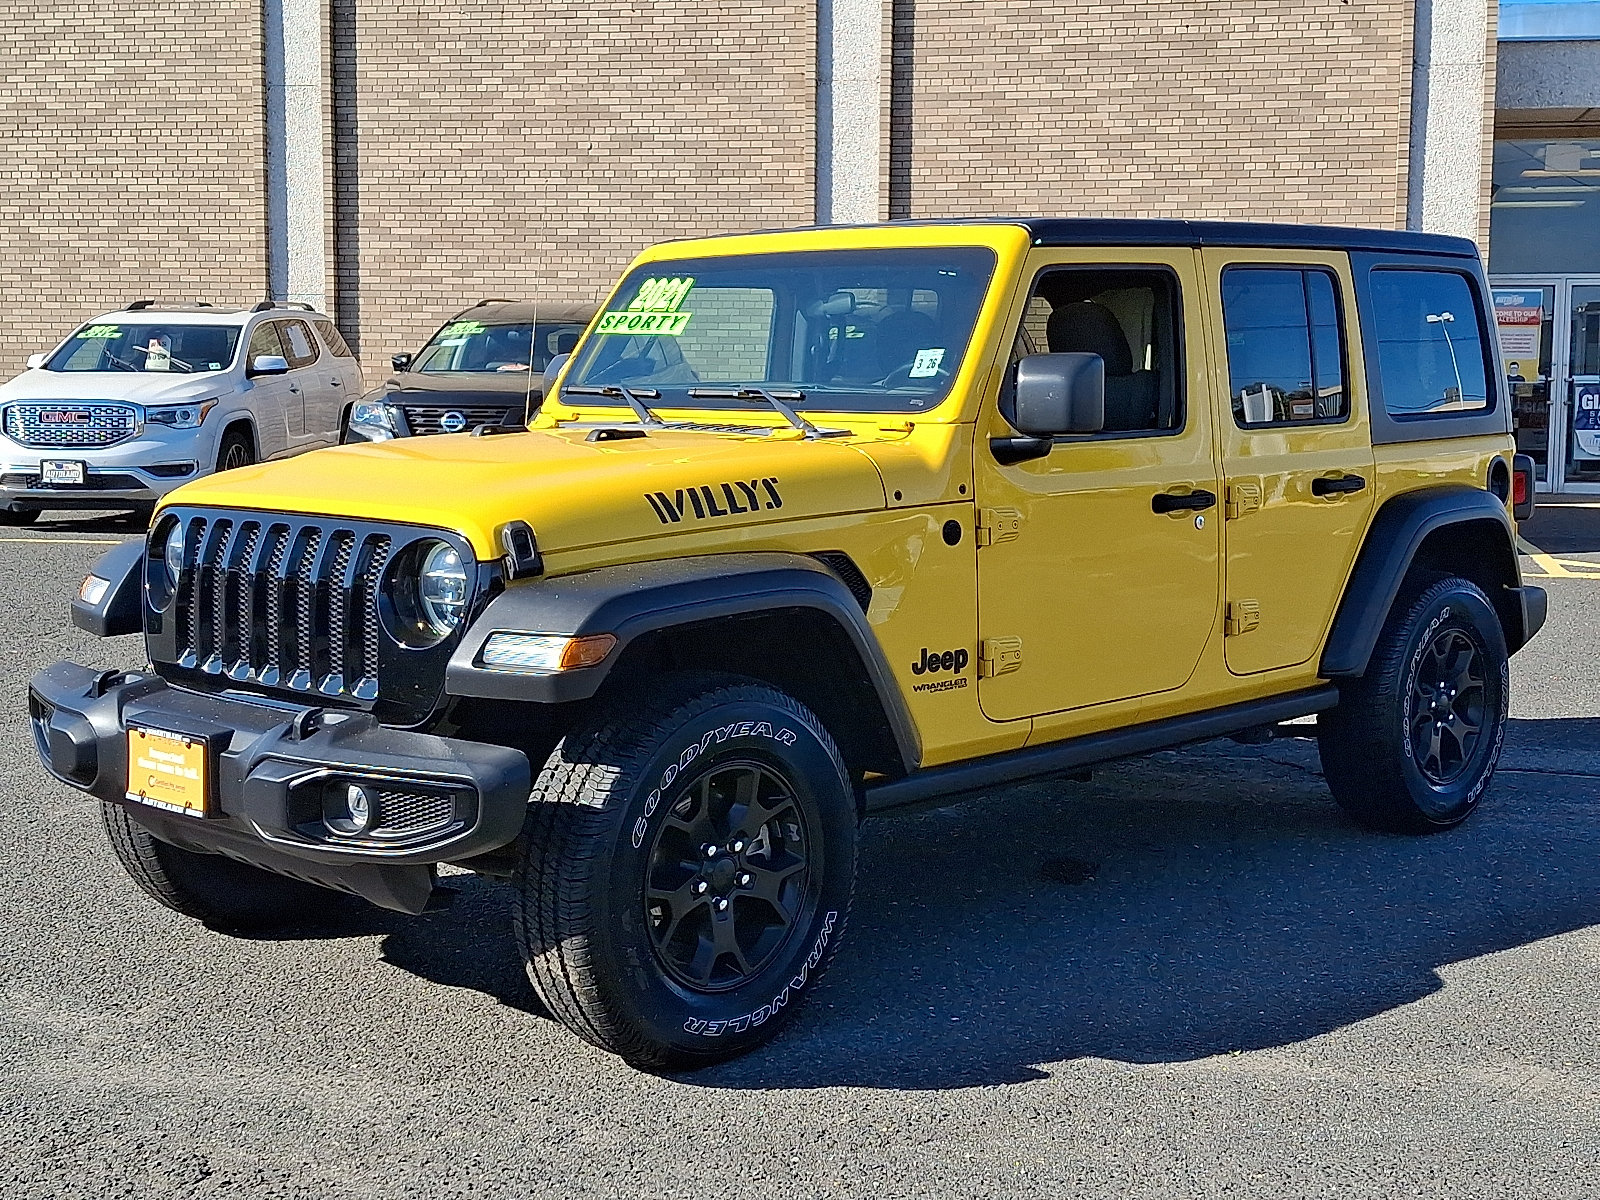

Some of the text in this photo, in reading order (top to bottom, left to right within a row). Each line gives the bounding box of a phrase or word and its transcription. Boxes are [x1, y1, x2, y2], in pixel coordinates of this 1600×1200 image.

[628, 277, 695, 312] 2021
[600, 315, 686, 330] SPORTY
[917, 359, 938, 369] 3 26
[1581, 394, 1600, 410] GI
[41, 411, 90, 423] GMC
[45, 469, 81, 478] AUTOLAND
[643, 477, 783, 524] WILLYS
[911, 647, 969, 675] Jeep
[912, 677, 968, 692] WRANGLER
[1403, 606, 1451, 758] GOODYEAR
[631, 721, 797, 849] GOODYEAR
[683, 911, 838, 1037] WRANGLER
